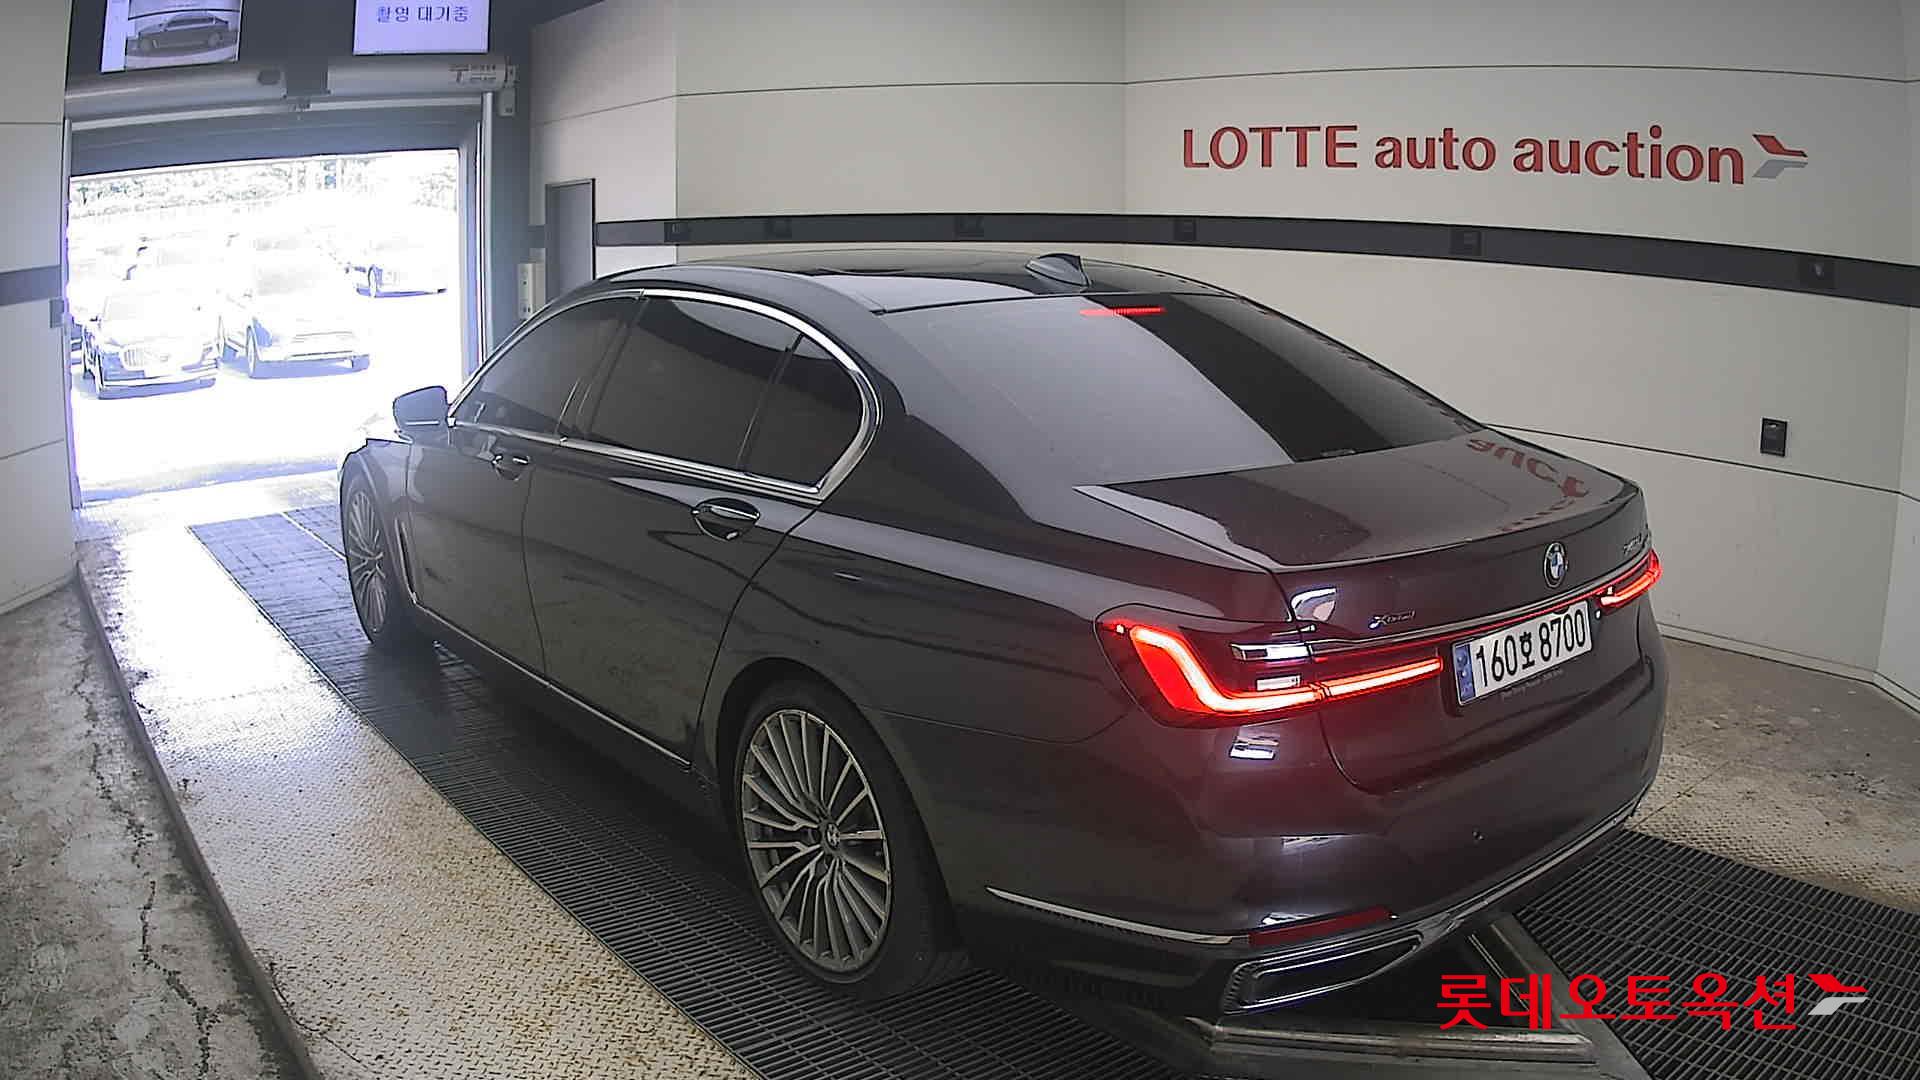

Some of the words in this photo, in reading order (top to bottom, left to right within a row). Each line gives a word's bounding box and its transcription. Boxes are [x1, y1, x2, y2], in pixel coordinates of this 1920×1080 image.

[417, 5, 469, 22] 대기중
[1183, 125, 1361, 170] LOTTE
[1375, 128, 1500, 172] auto
[1511, 126, 1745, 185] auction
[1476, 631, 1535, 687] 160호
[1538, 609, 1587, 662] 8700
